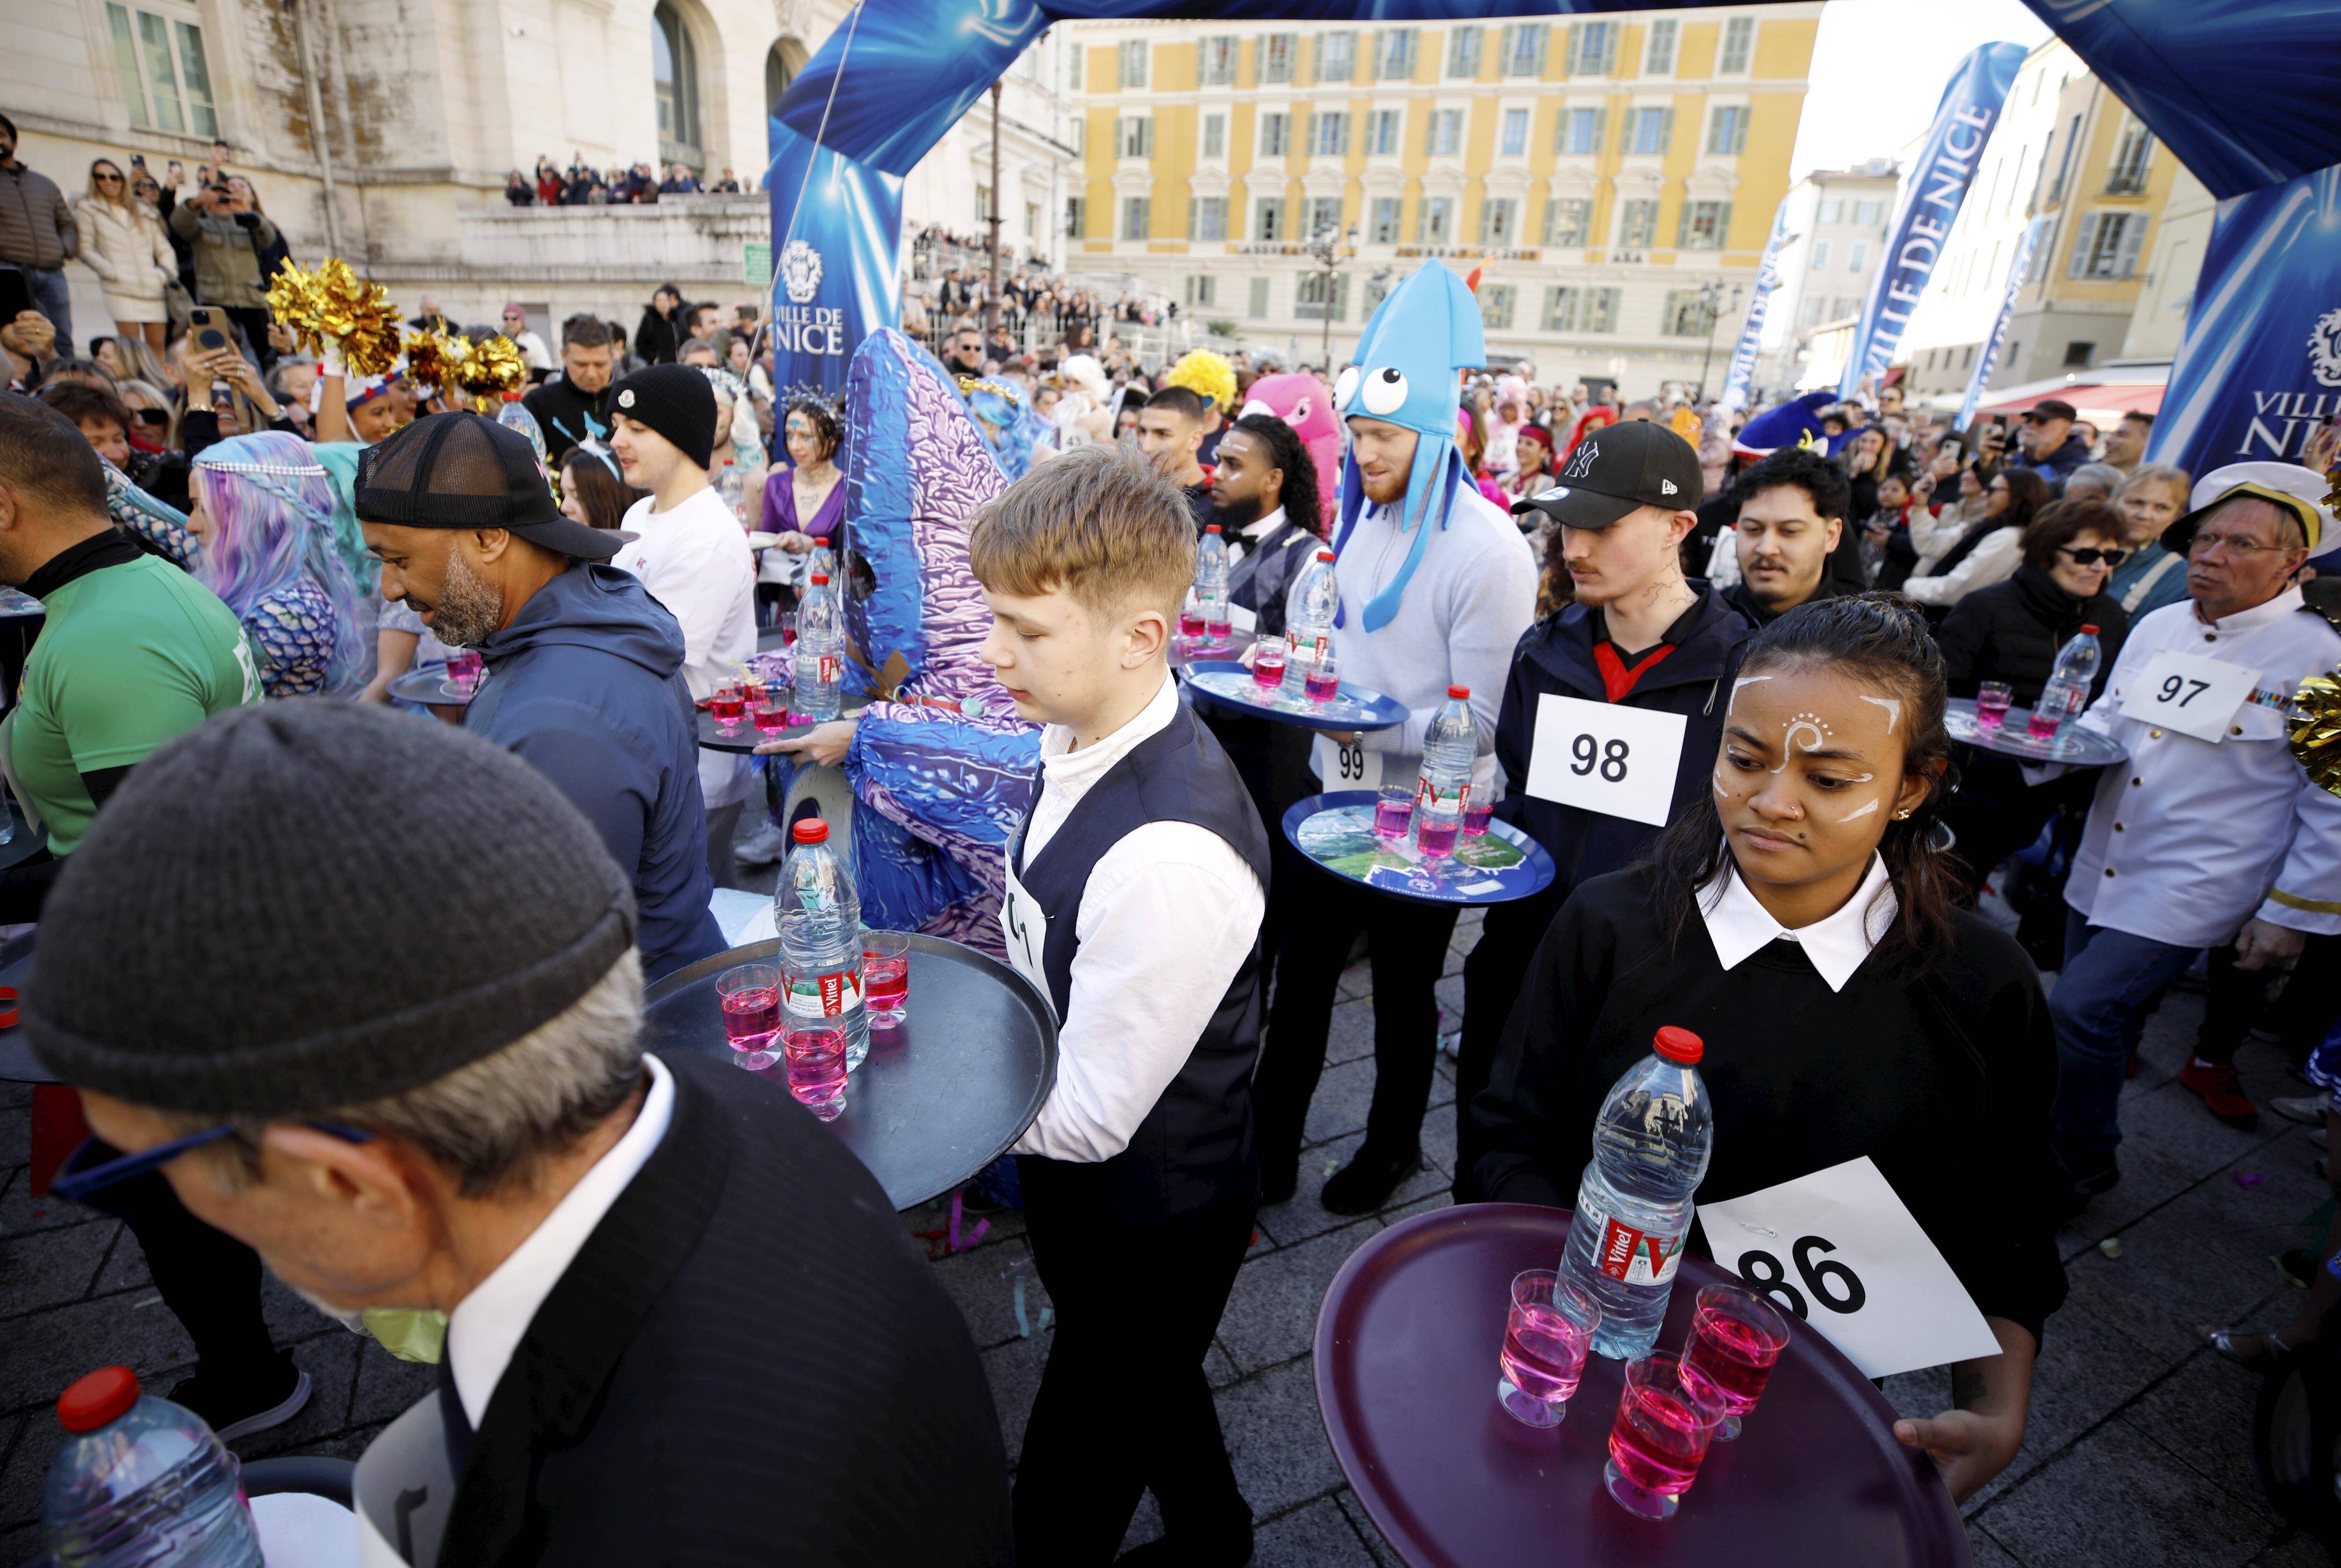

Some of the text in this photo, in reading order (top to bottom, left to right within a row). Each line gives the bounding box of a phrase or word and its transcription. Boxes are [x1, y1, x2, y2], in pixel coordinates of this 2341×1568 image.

[1898, 214, 1948, 273] DE
[1923, 99, 1992, 211] NICE
[774, 305, 843, 326] VILLE DE
[776, 323, 844, 356] NICE
[2157, 675, 2211, 707] 97
[1340, 747, 1363, 781] 99
[1570, 733, 1630, 783] 98
[1428, 783, 1446, 808] V
[780, 968, 795, 1005] V
[825, 977, 839, 1007] Vittel
[846, 961, 864, 998] V
[1608, 1228, 1632, 1264] Vittel
[1644, 1236, 1680, 1279] V
[1737, 1235, 1866, 1321] 86
